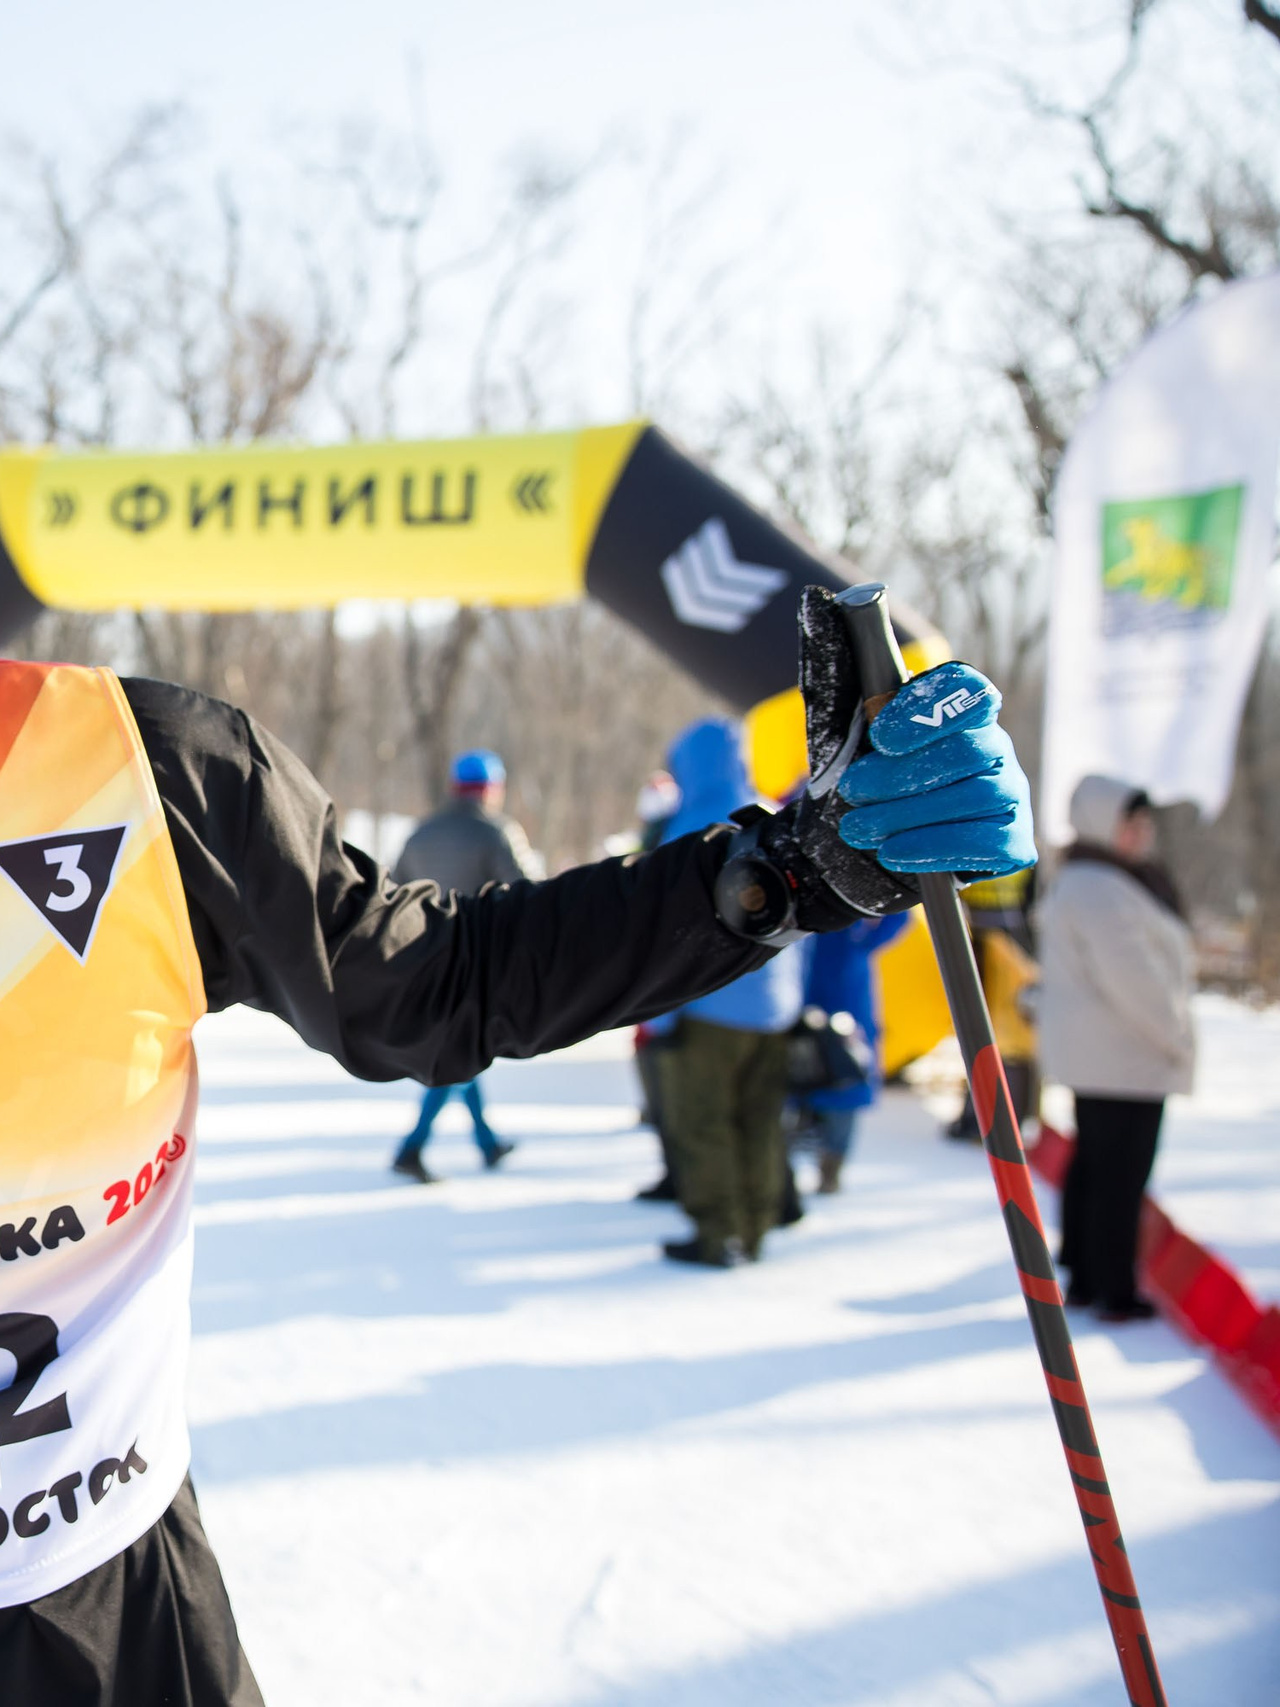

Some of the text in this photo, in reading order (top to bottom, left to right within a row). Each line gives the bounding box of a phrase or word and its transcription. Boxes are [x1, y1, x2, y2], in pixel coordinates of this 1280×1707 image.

[109, 469, 480, 534] ФИНИШ
[909, 687, 971, 727] VIP
[43, 843, 94, 914] 3
